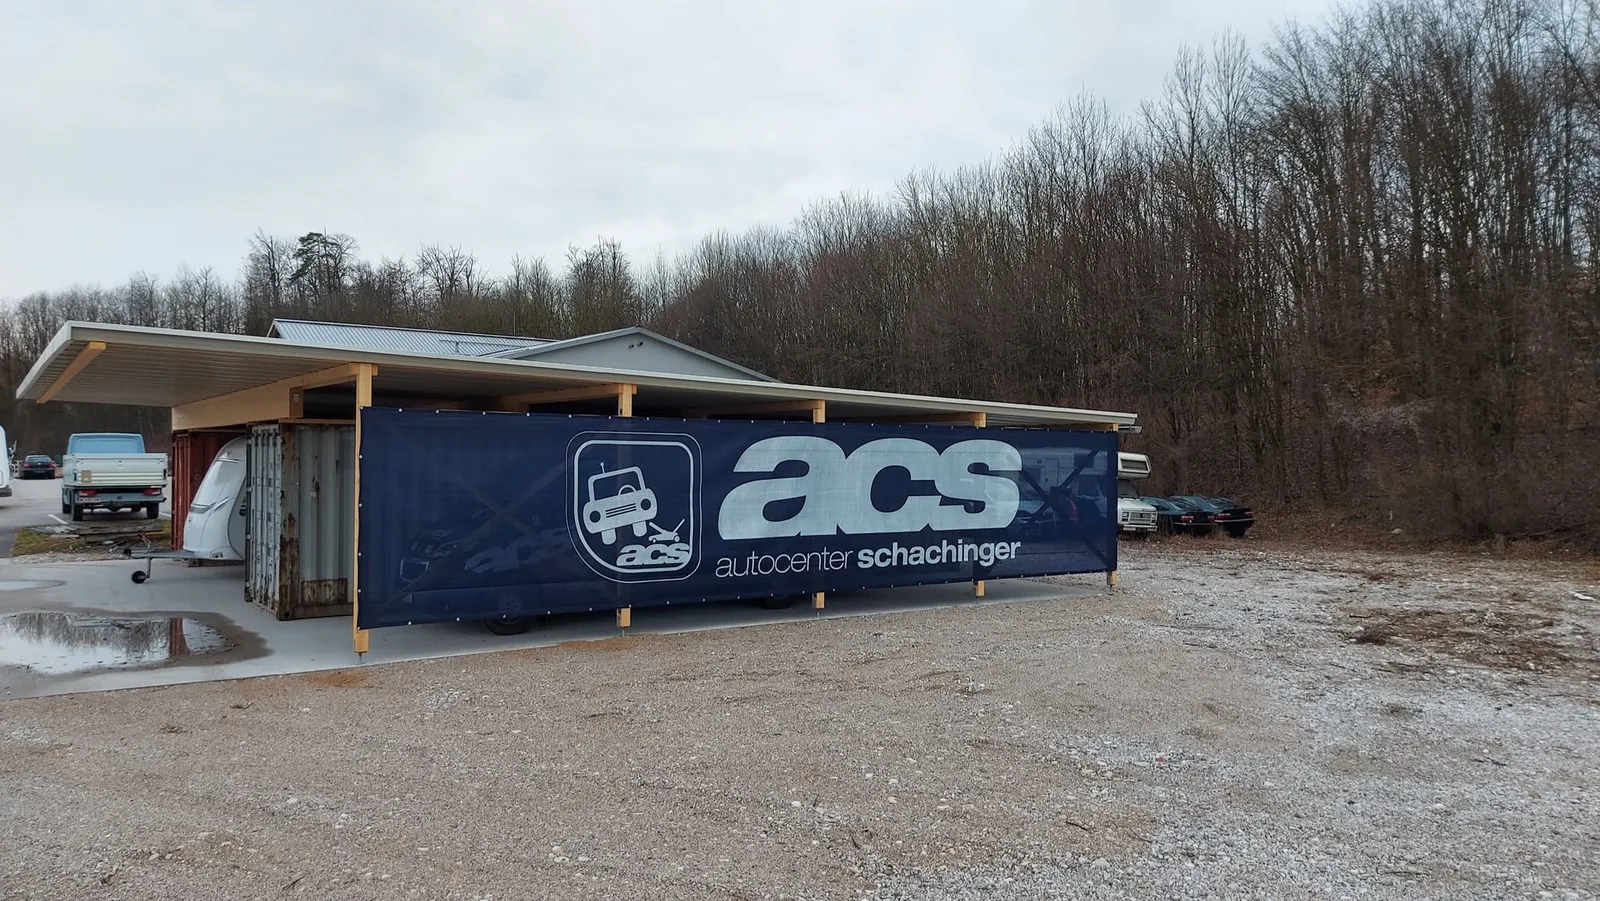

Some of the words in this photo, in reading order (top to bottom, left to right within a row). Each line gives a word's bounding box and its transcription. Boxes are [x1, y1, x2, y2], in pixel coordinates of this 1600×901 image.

[718, 435, 1023, 540] acs
[616, 543, 690, 566] acs
[715, 546, 854, 578] autocenter
[857, 539, 1022, 569] schachinger
